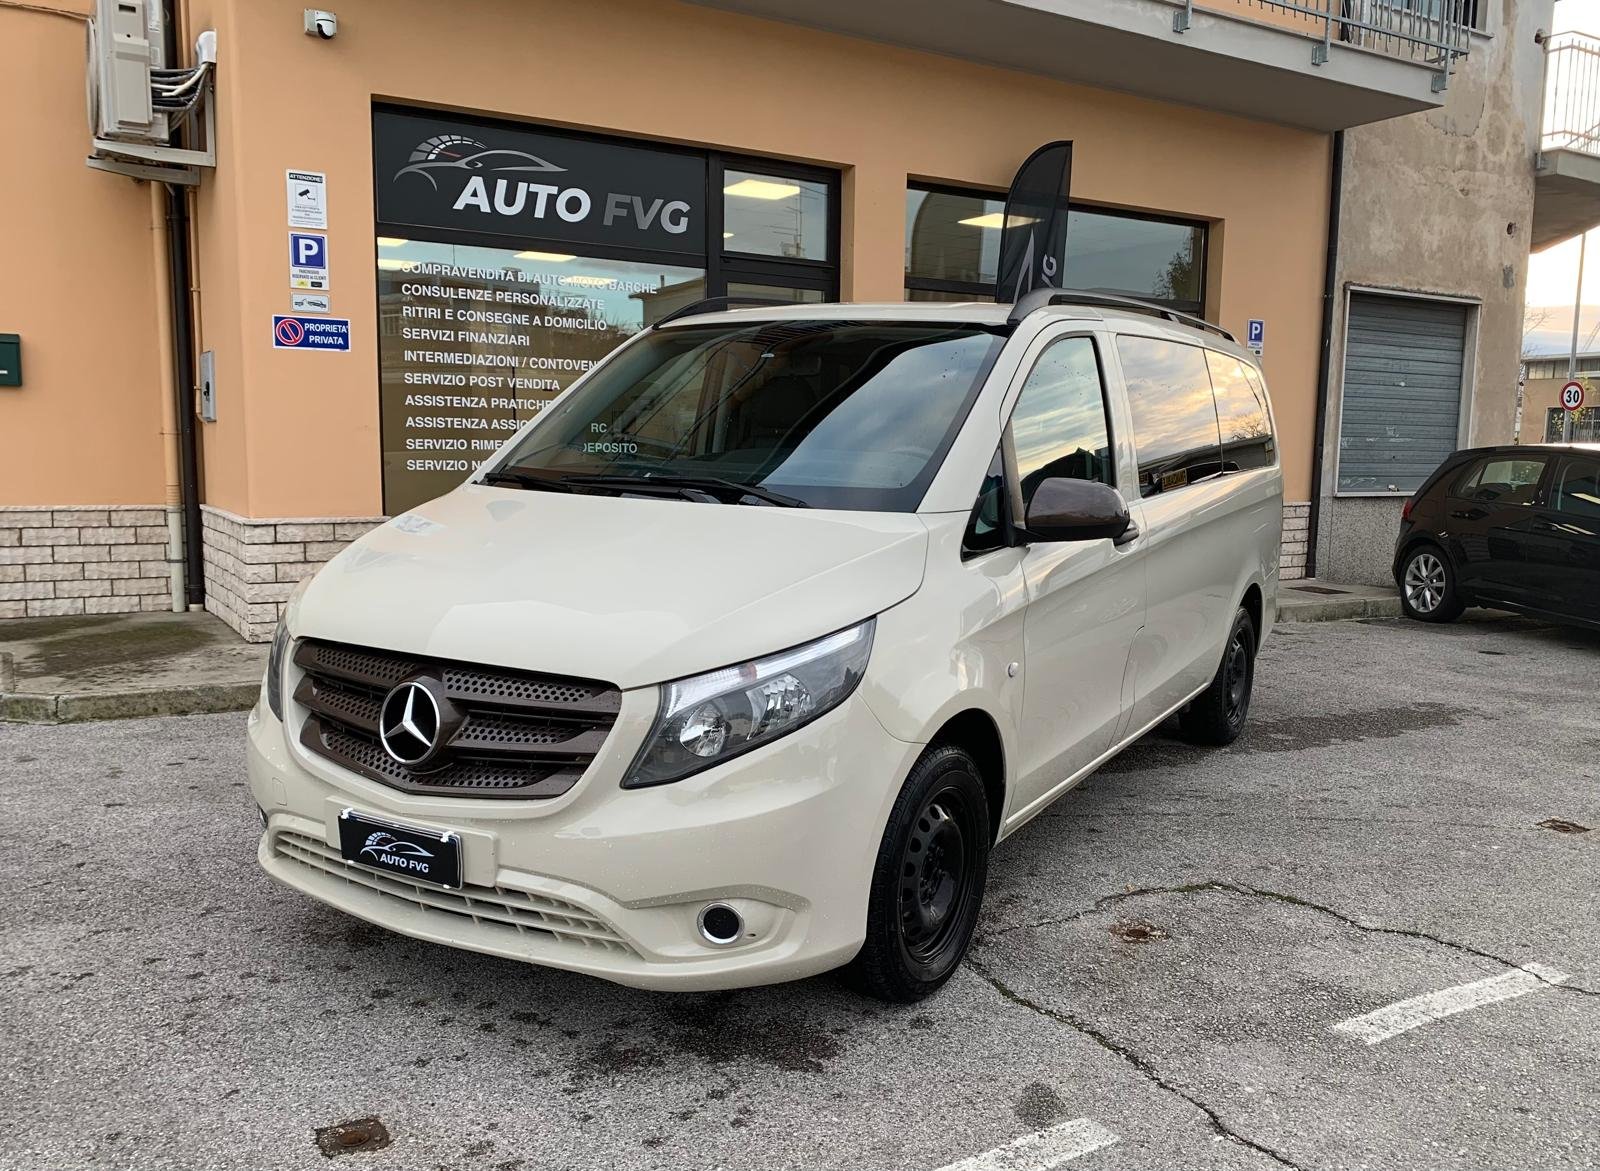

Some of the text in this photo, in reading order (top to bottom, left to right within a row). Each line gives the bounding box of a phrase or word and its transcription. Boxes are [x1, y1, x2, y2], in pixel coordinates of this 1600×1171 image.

[453, 175, 692, 235] AUTO FVG
[299, 238, 319, 264] P
[402, 263, 514, 282] COMPRAVENDITA
[531, 273, 566, 286] AUTO
[570, 277, 608, 290] MOTO
[609, 281, 657, 294] BARCHE
[401, 283, 605, 310] CONSULENZE PERSONALIZZATE
[402, 306, 607, 332] RITIRI E CONSEGNE A DOMICILIO
[309, 335, 344, 345] PRIVATA
[402, 327, 530, 346] SERVIZI FINANZIARI
[1251, 322, 1261, 340] P
[404, 350, 519, 368] INTERMEDIAZIONI
[529, 357, 600, 372] CONTOVEN
[404, 373, 560, 391] SERVIZIO POST VENDITA
[405, 395, 488, 409] ASSISTENZA
[1565, 389, 1580, 404] 30
[406, 416, 488, 430] ASSISTENZA
[590, 422, 607, 433] RC
[406, 438, 467, 451] SERVIZIO
[406, 459, 467, 472] SERVIZIO
[380, 853, 430, 873] AUTO FVG
